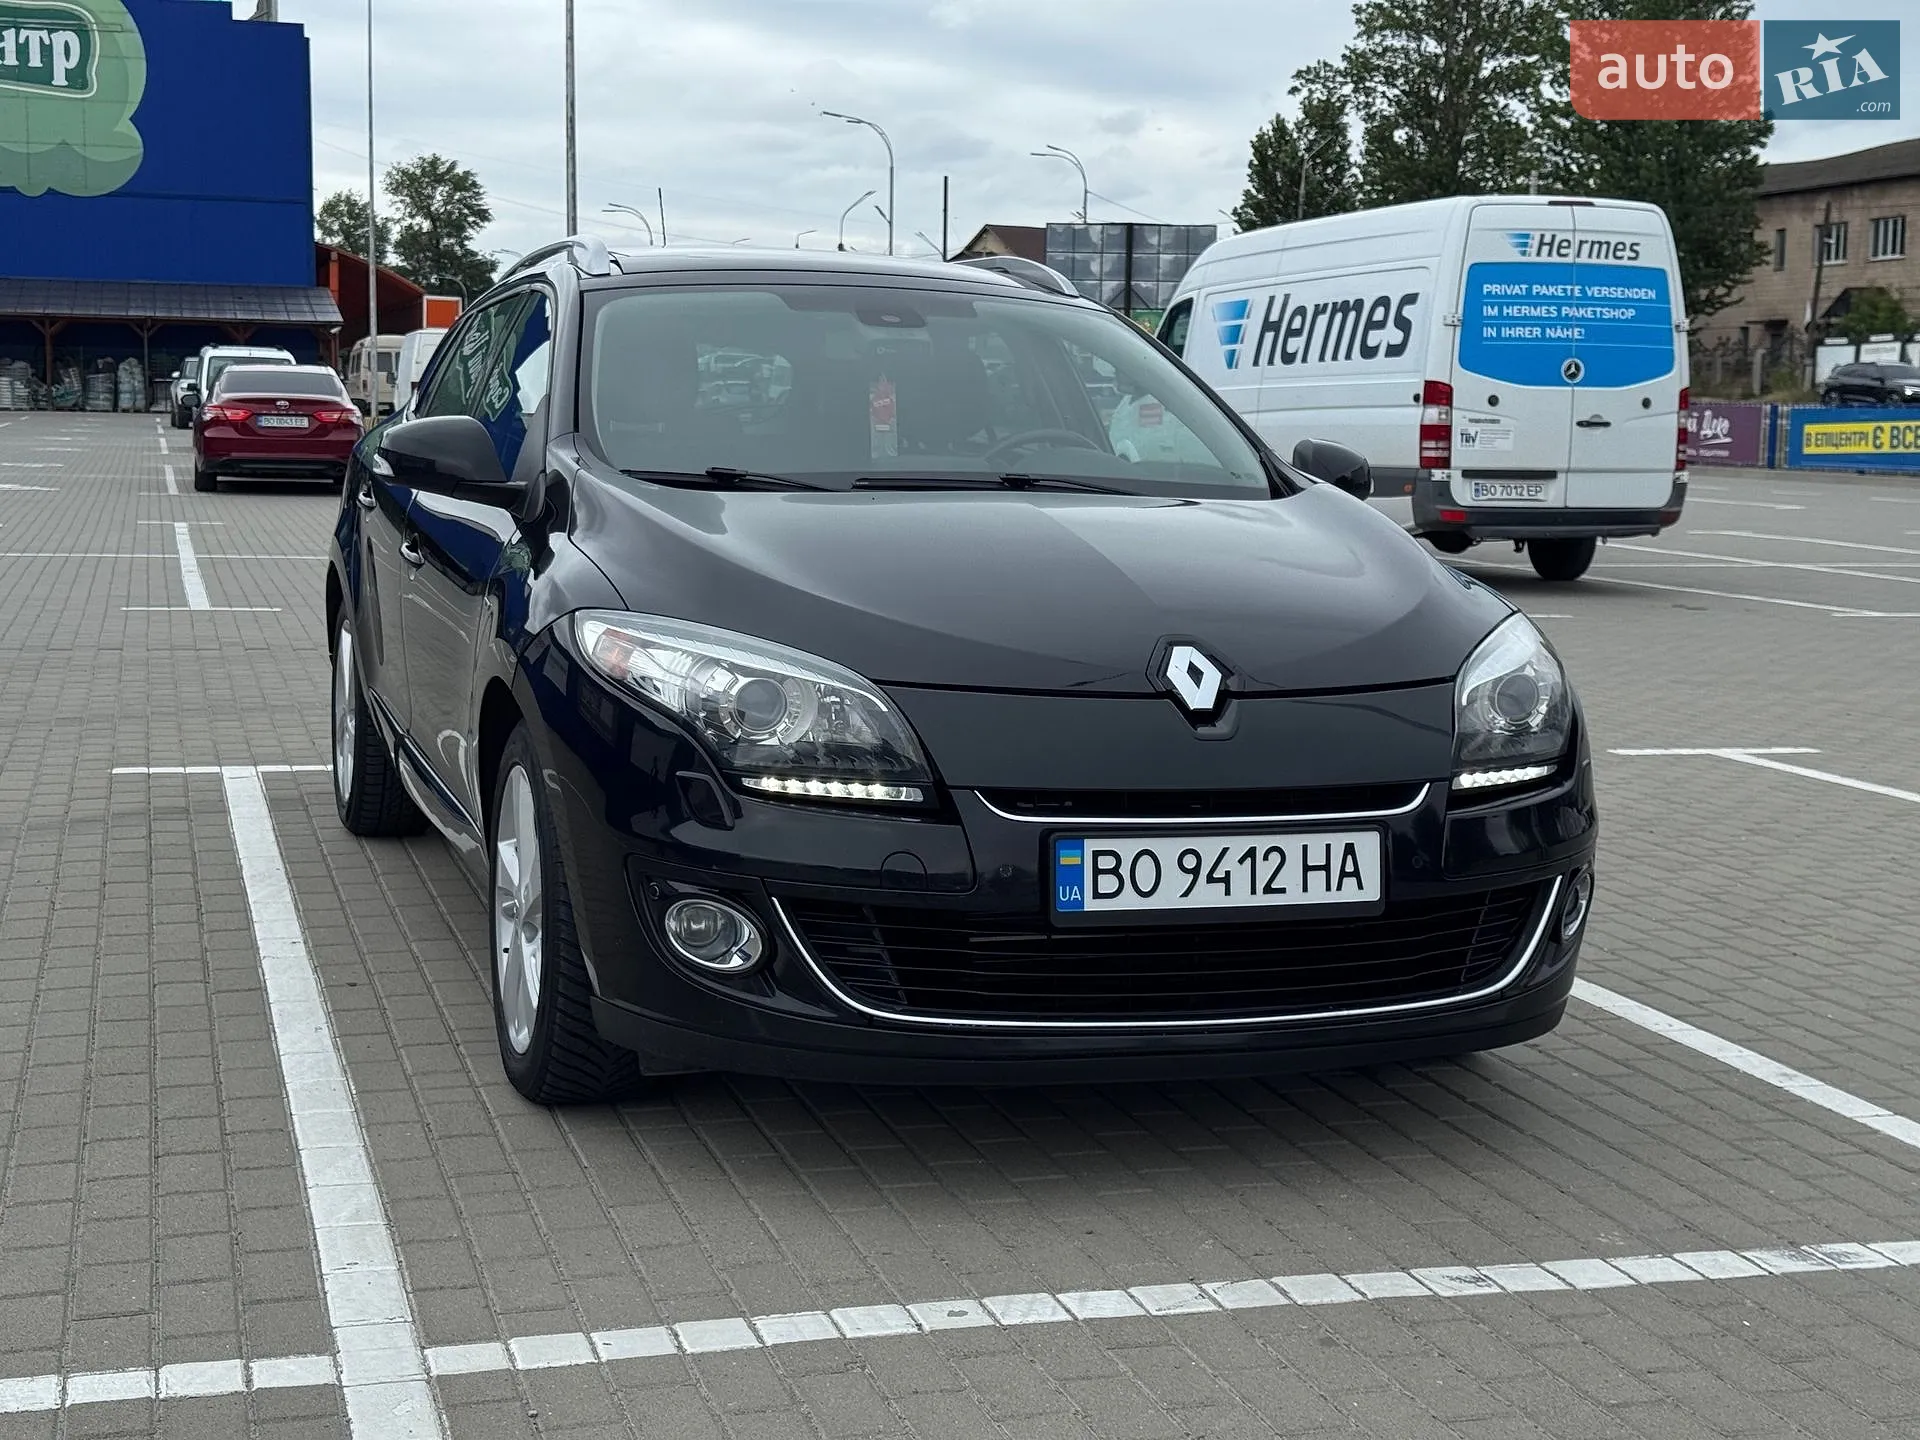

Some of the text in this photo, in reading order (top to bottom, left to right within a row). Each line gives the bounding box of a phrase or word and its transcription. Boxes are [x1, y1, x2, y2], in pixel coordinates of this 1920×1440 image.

[1536, 233, 1641, 261] Hermes
[1482, 284, 1656, 300] PRIVAT PAKETE VERSENDEN
[1482, 305, 1636, 320] IM HERMES PAKETSHOP
[1252, 292, 1420, 368] Hermes
[1482, 326, 1497, 338] IN
[1501, 326, 1542, 338] IHRER
[1481, 485, 1543, 497] BO 7012 EP
[1091, 842, 1364, 900] BO 9412 HA
[1059, 886, 1082, 901] UA
